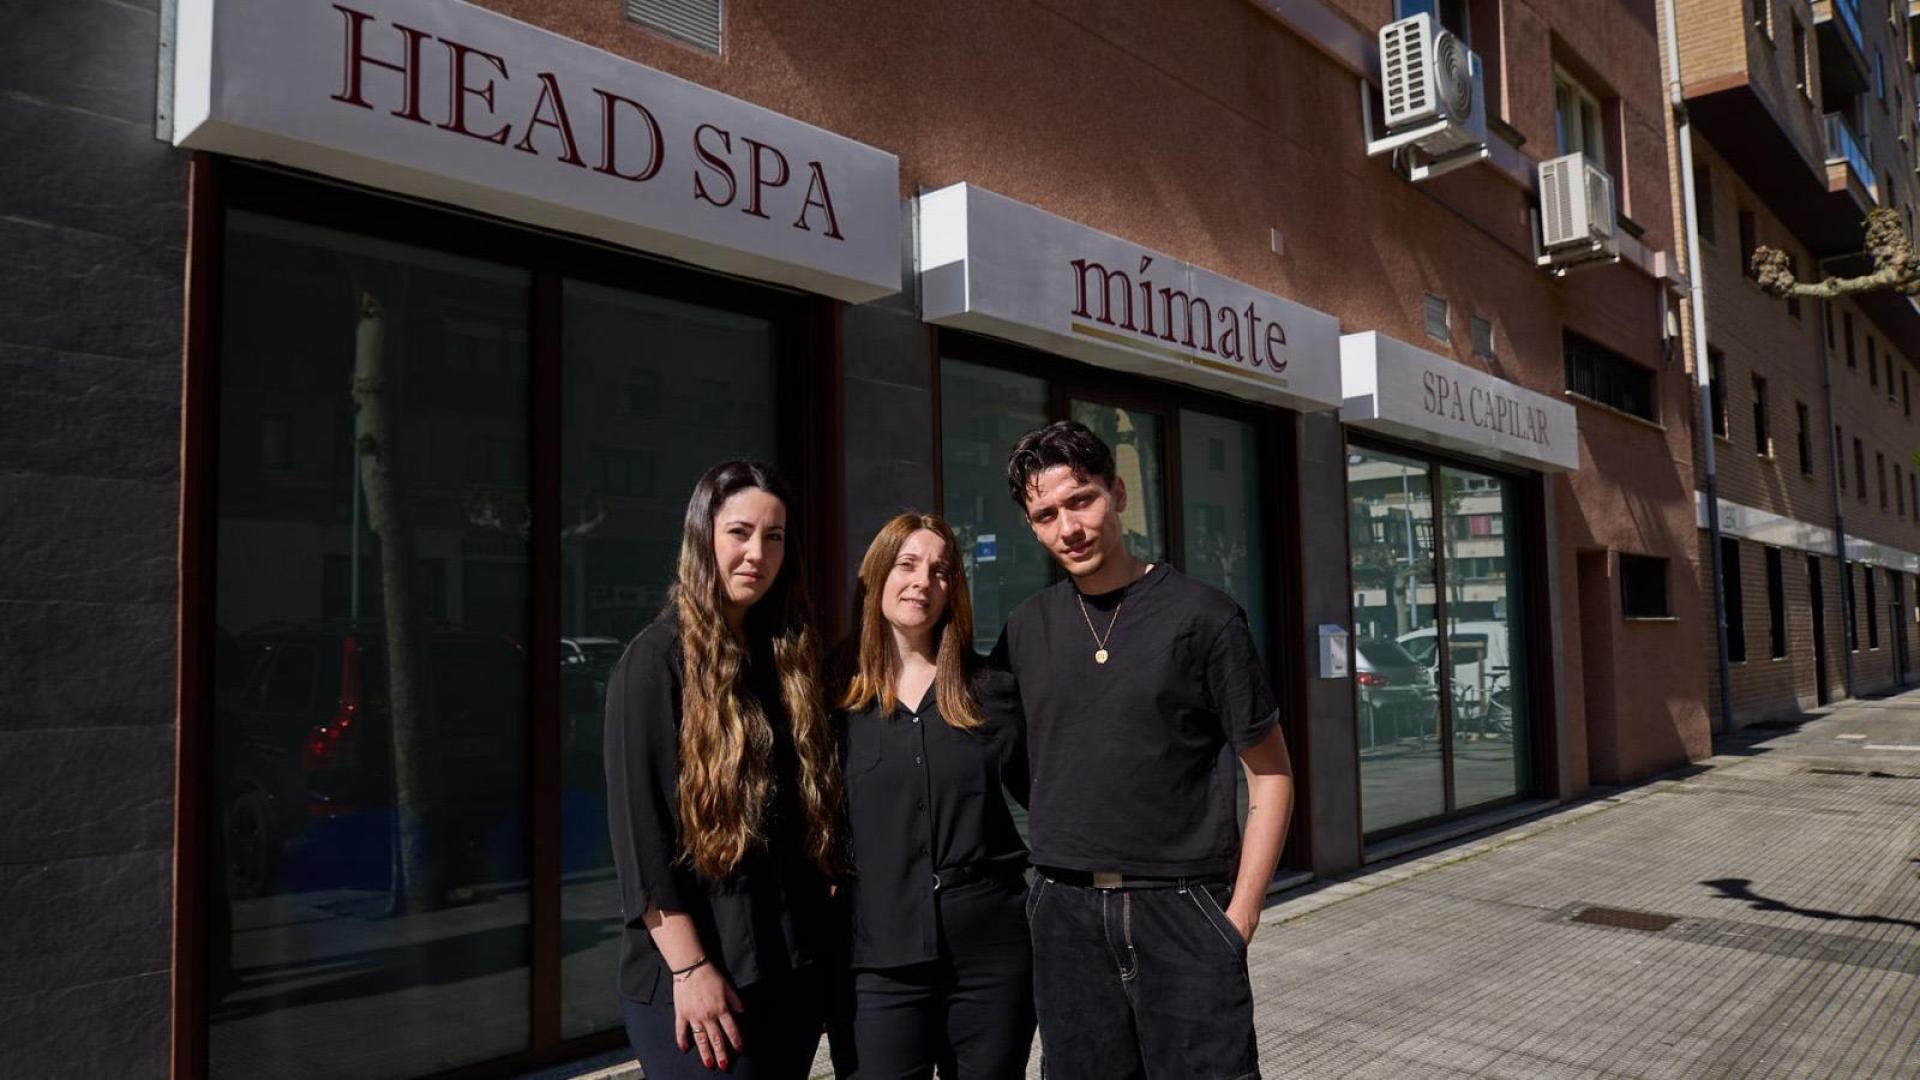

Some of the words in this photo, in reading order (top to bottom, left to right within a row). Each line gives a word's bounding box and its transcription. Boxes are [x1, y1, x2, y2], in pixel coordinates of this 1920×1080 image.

[331, 5, 664, 182] HEAD
[693, 124, 846, 241] SPA
[1070, 256, 1288, 373] mímate
[1422, 369, 1465, 422] SPA
[1469, 386, 1550, 446] CAPILAR
